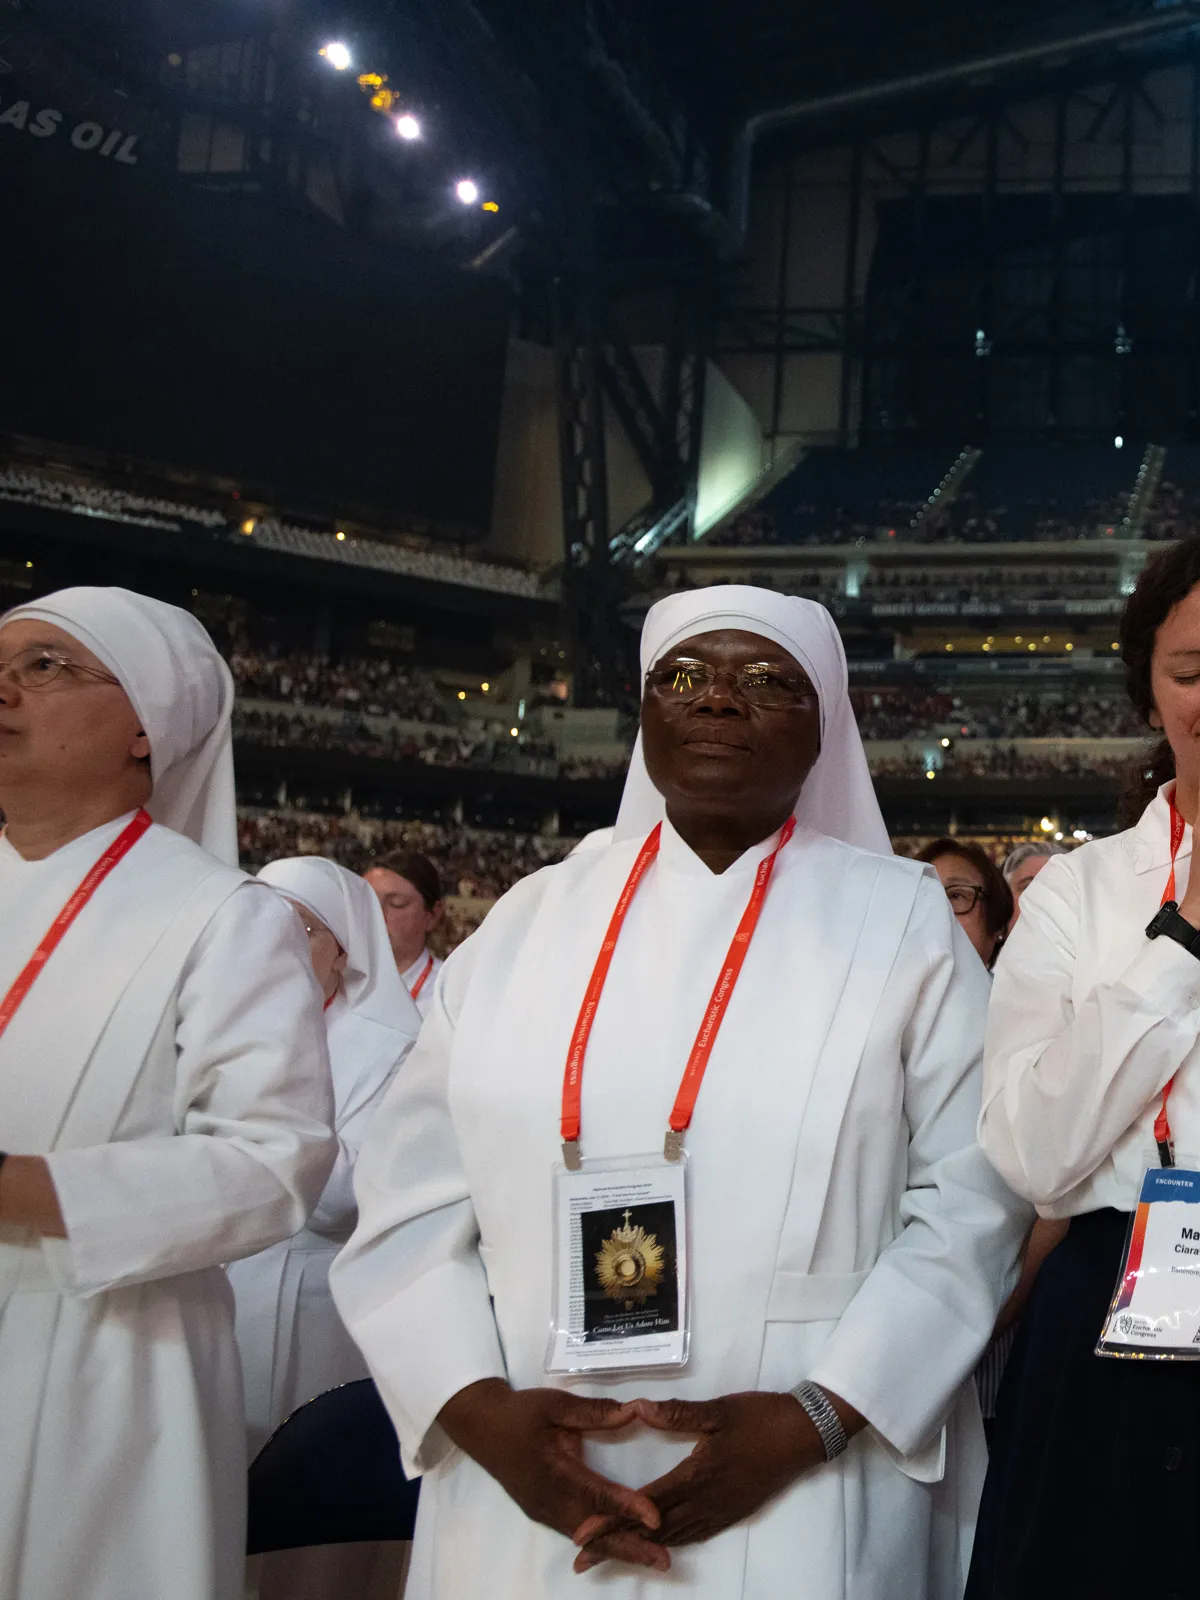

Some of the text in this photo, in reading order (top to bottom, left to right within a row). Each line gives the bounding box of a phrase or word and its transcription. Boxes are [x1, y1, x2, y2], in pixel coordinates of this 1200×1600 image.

[70, 120, 139, 165] OIL
[697, 1004, 721, 1048] Eucharistic
[714, 968, 733, 1003] Congress
[569, 1001, 596, 1086] Eucharistic Congress
[1155, 1178, 1194, 1188] ENCOUNTER
[625, 1322, 634, 1330] Us
[635, 1320, 654, 1329] Adore
[654, 1317, 671, 1326] Him
[1130, 1329, 1157, 1339] Congress
